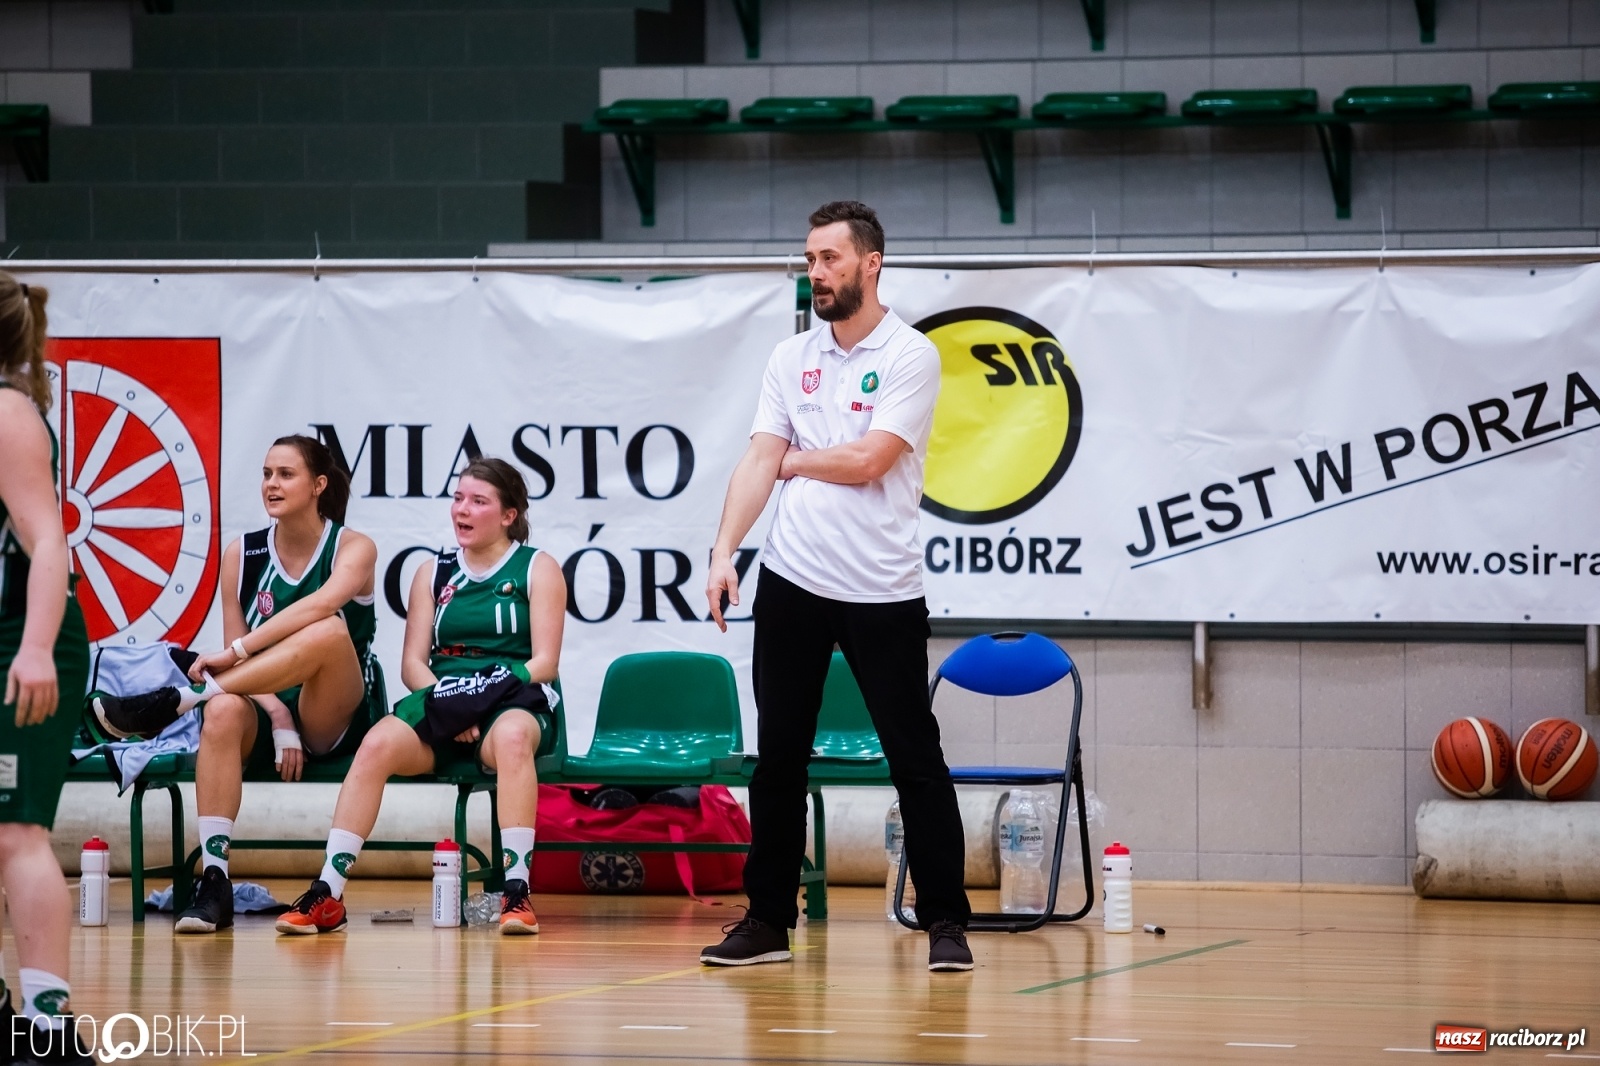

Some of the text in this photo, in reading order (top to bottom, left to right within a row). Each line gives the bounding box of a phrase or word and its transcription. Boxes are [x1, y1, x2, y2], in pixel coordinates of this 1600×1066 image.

[1126, 371, 1600, 558] JEST W PORZA
[924, 527, 1082, 574] CIBÓRZ
[1376, 544, 1600, 576] www.osir-ra
[494, 602, 518, 635] 11
[1542, 727, 1573, 770] molten
